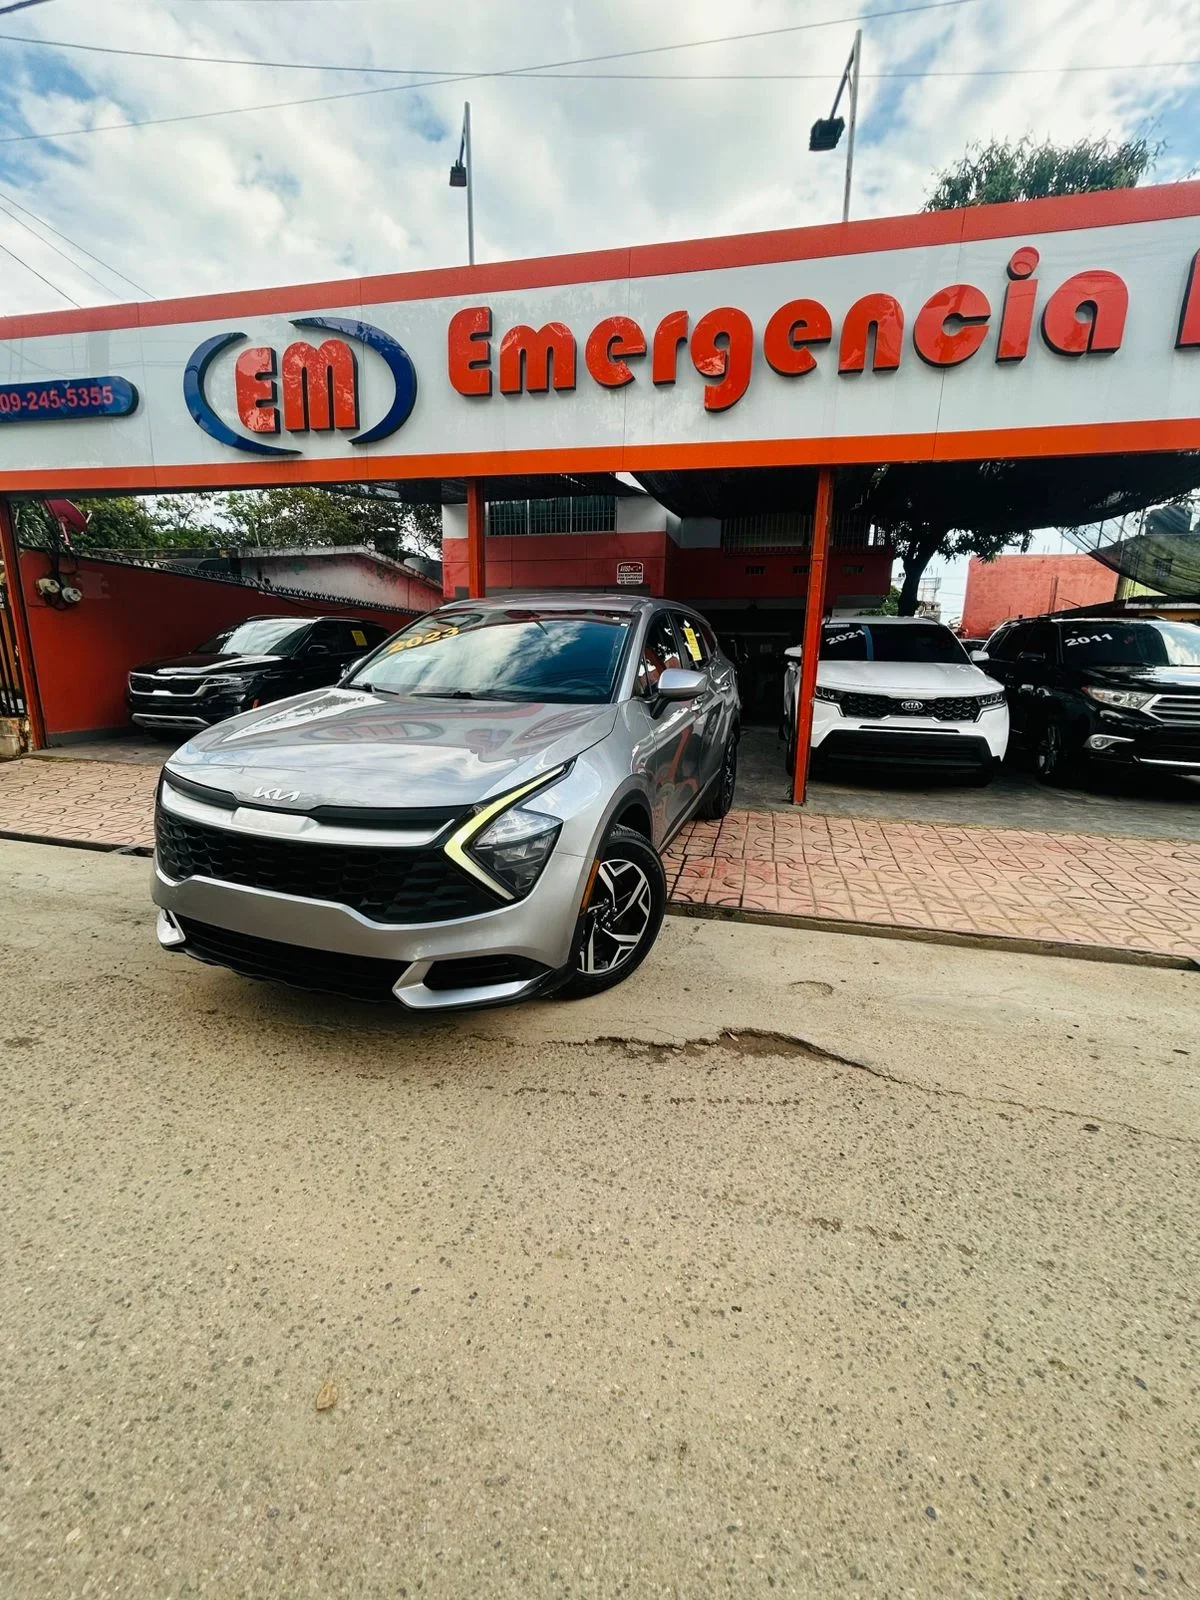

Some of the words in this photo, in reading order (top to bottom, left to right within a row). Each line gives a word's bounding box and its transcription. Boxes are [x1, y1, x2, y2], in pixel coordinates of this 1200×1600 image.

[448, 246, 1129, 413] Emergencia
[235, 340, 360, 433] EM
[387, 626, 460, 655] 2023
[826, 630, 866, 645] 2021
[1064, 633, 1113, 647] 2011
[903, 701, 921, 710] KIA
[253, 786, 301, 802] KIA
